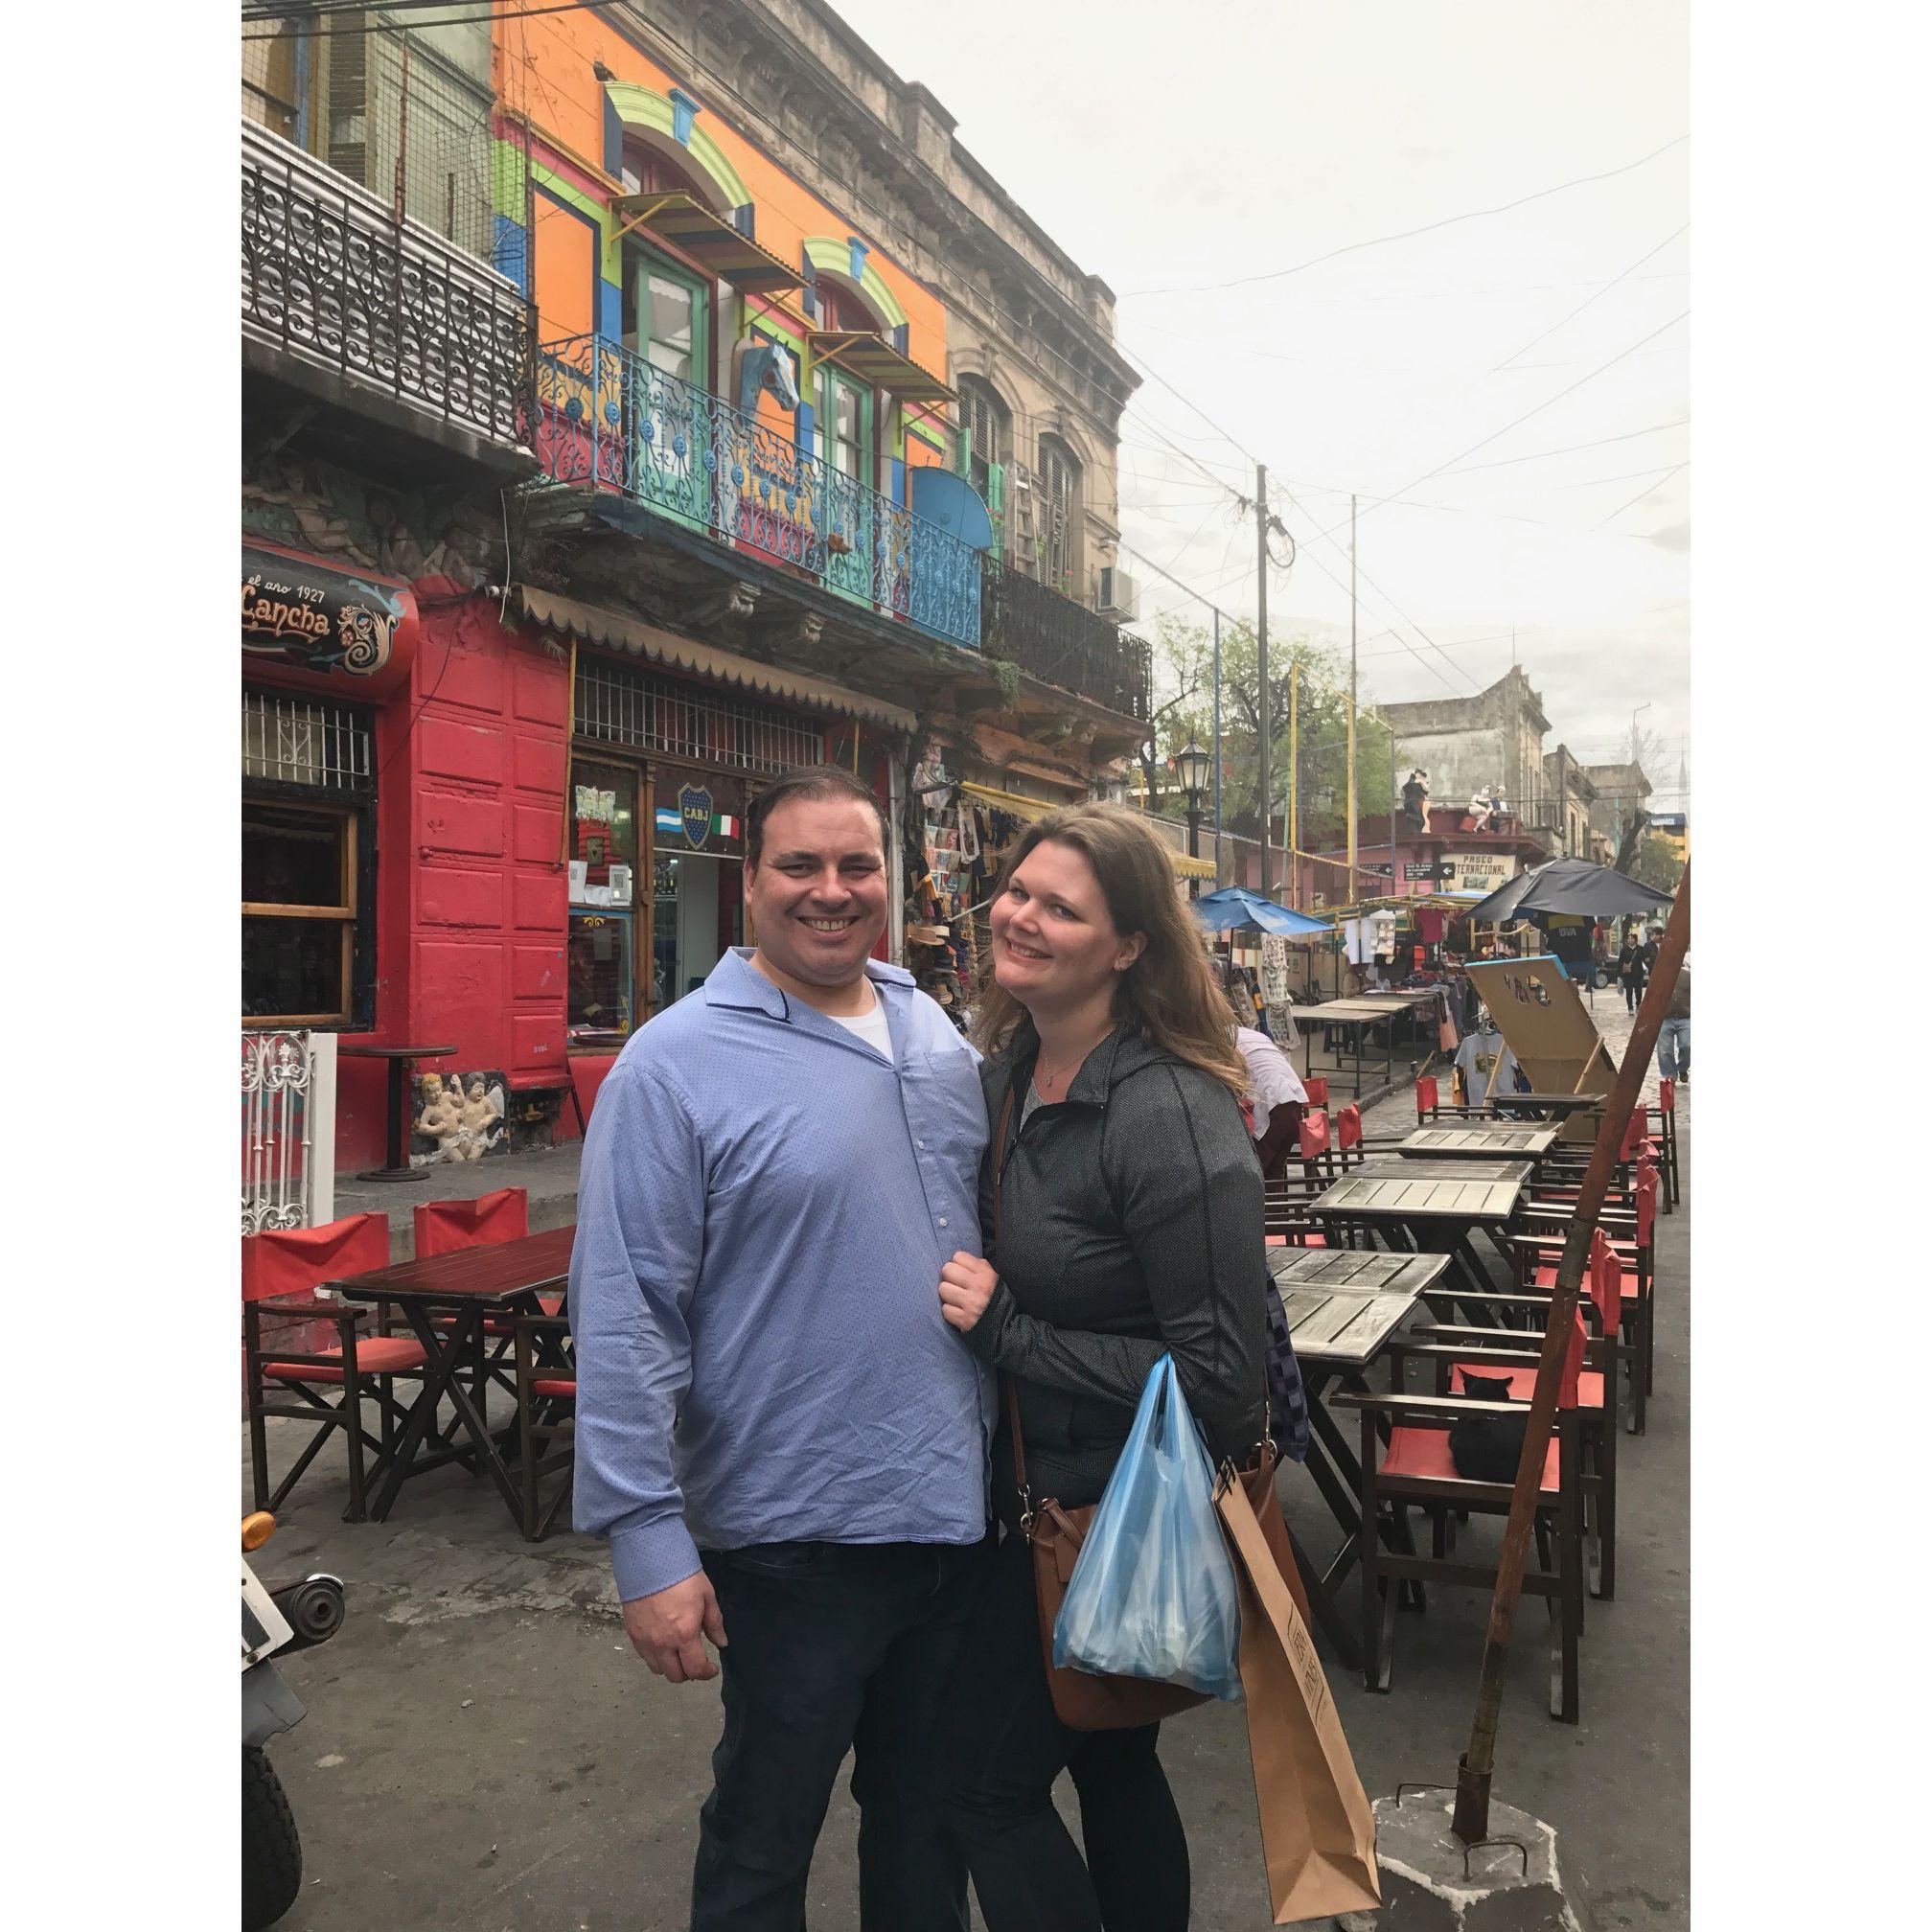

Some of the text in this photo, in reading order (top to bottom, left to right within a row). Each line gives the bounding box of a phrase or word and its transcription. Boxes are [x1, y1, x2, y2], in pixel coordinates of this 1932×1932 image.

[247, 574, 262, 586] el
[297, 585, 325, 604] 1927
[242, 584, 331, 637] Cancha
[684, 807, 708, 821] CABJ
[1463, 855, 1493, 863] PASEO
[1457, 863, 1506, 876] TERNACIONAL
